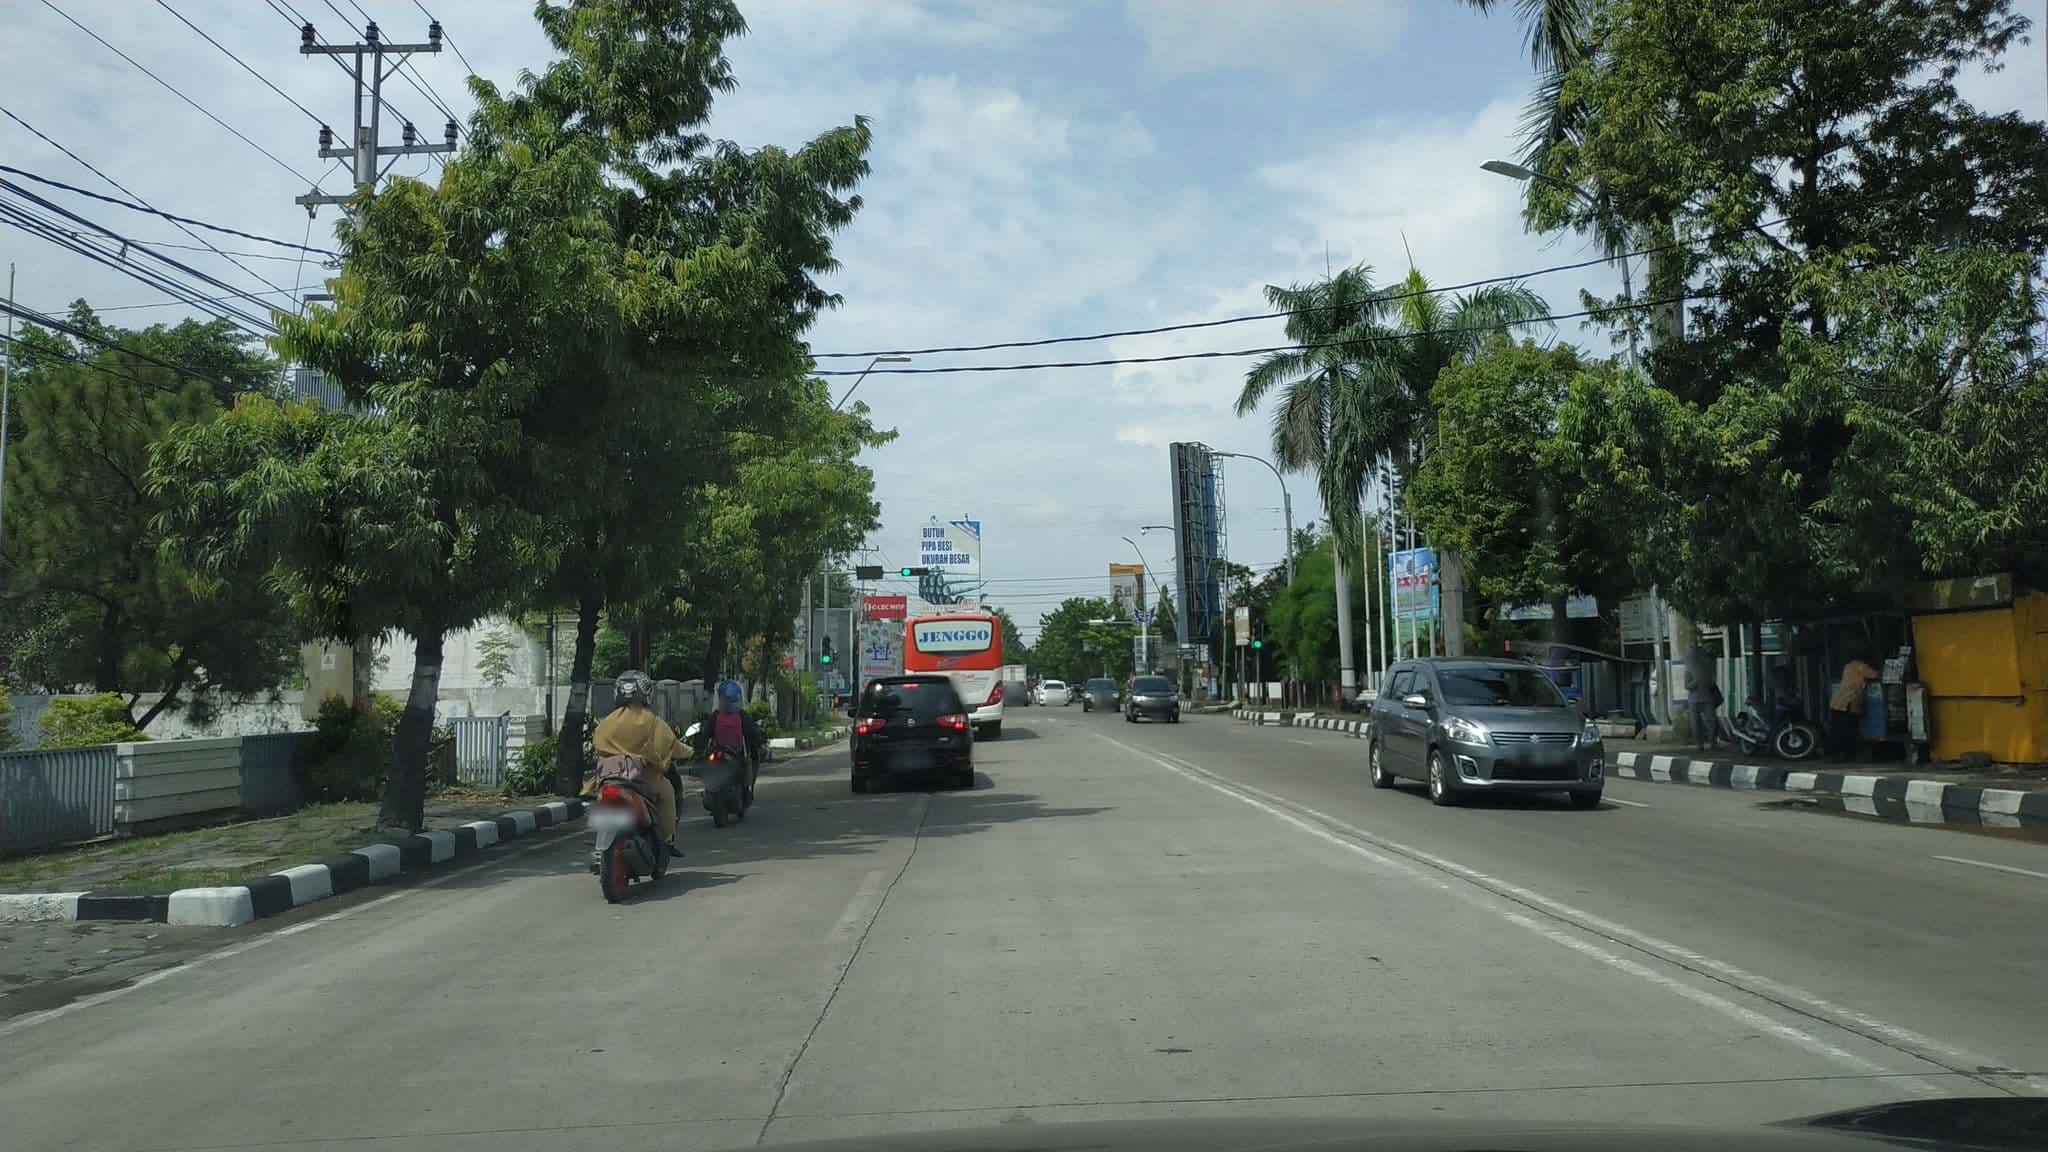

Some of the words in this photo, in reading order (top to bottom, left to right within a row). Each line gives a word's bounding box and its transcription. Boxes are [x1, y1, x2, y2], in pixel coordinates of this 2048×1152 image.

[922, 527, 945, 538] BUTUH
[921, 540, 936, 551] PIPA
[937, 540, 952, 551] BESI
[921, 553, 948, 564] UKURAN
[949, 553, 970, 564] BESAR
[918, 629, 990, 643] JENGGO
